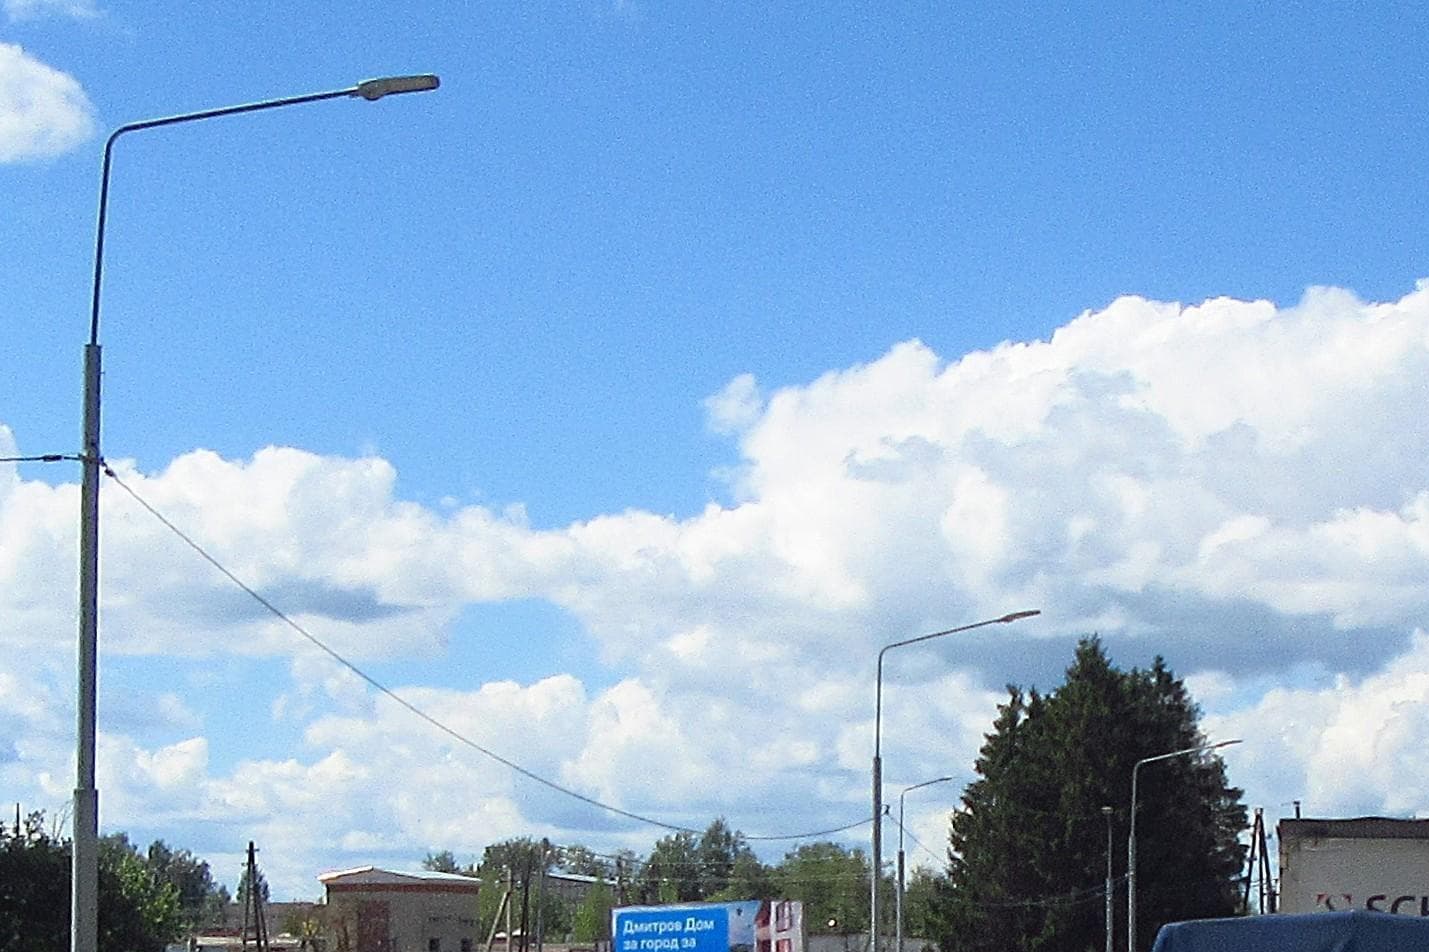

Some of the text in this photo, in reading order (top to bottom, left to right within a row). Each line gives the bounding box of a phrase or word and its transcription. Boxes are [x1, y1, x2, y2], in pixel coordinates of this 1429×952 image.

[623, 917, 715, 936] Дмитров Дом
[623, 937, 697, 952] за город за
